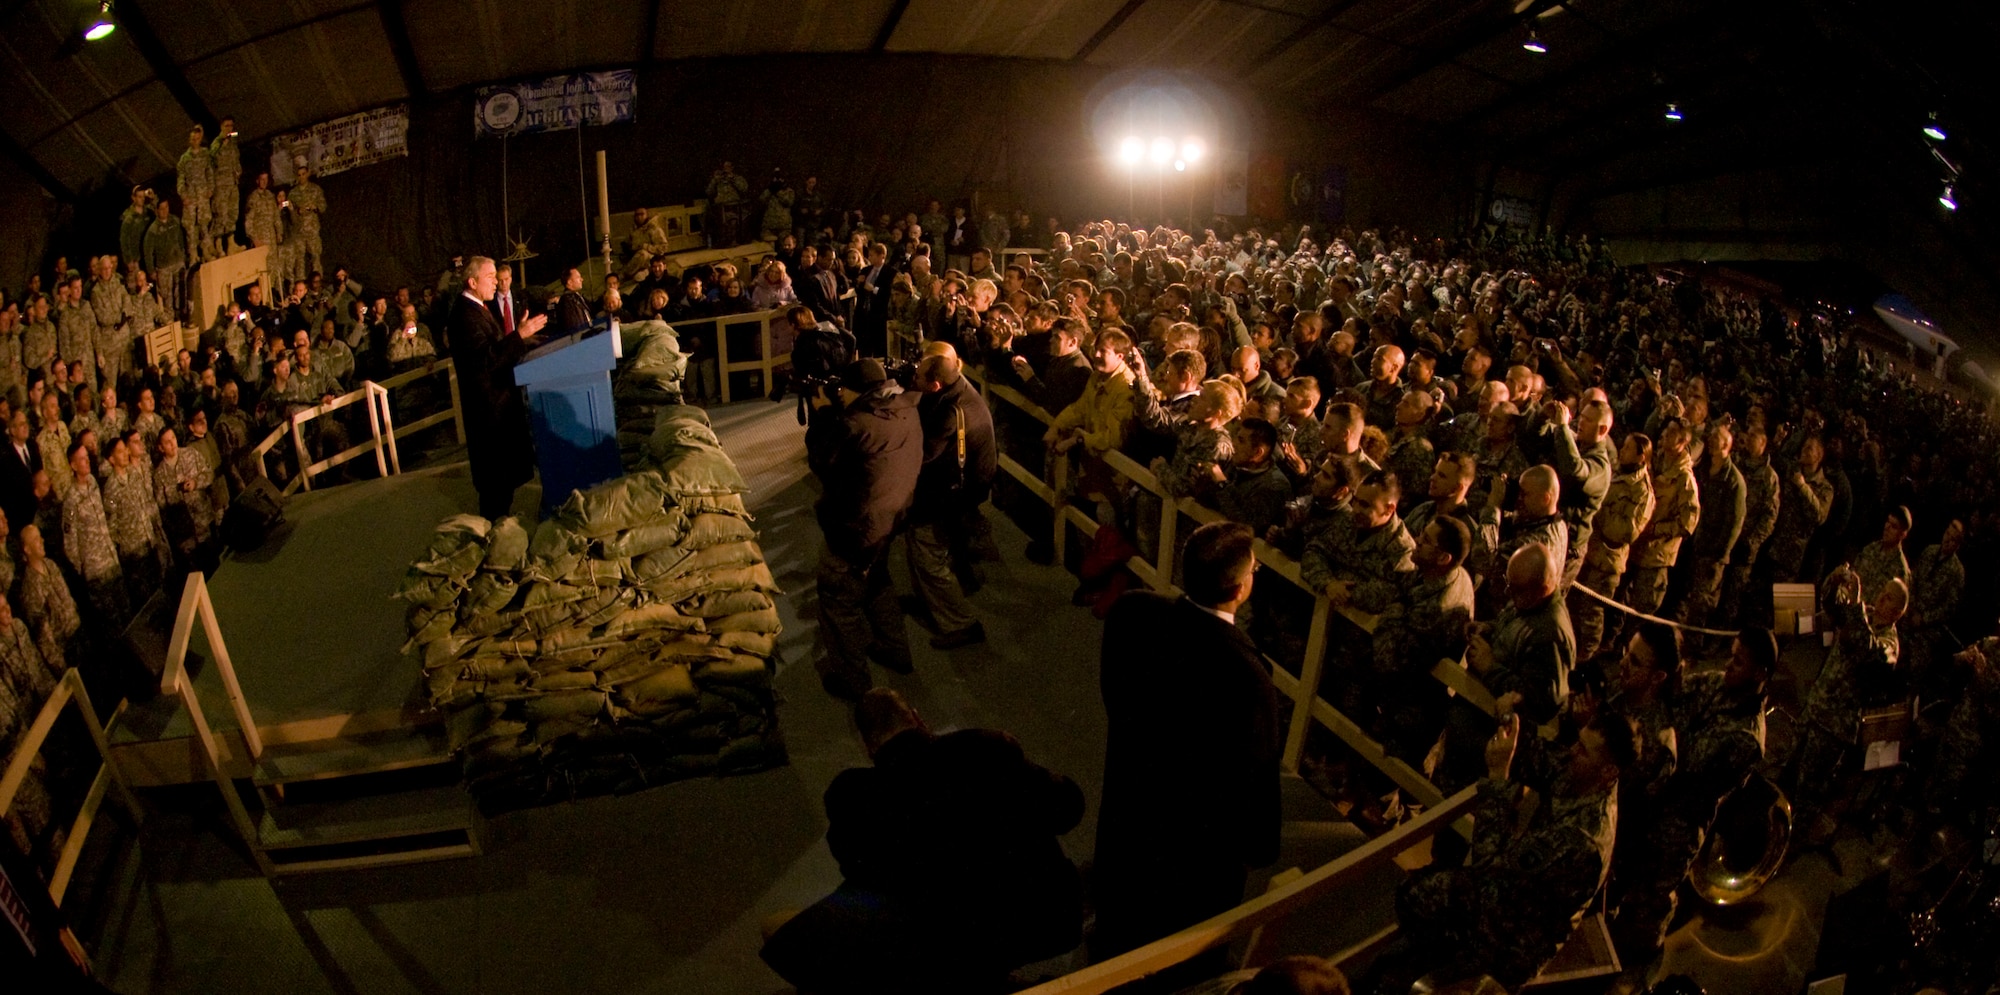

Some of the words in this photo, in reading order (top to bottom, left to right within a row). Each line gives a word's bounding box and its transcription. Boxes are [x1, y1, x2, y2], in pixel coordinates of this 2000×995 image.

[524, 86, 564, 99] Combined
[566, 83, 585, 95] Joint
[608, 78, 631, 90] Force
[526, 102, 630, 126] AFGHANISTAN
[290, 131, 315, 144] 101ST
[316, 117, 361, 135] AIRBORNE
[363, 107, 408, 123] DIVISION
[380, 118, 399, 129] STAY
[379, 127, 399, 138] ARMY
[374, 136, 404, 149] STRONG
